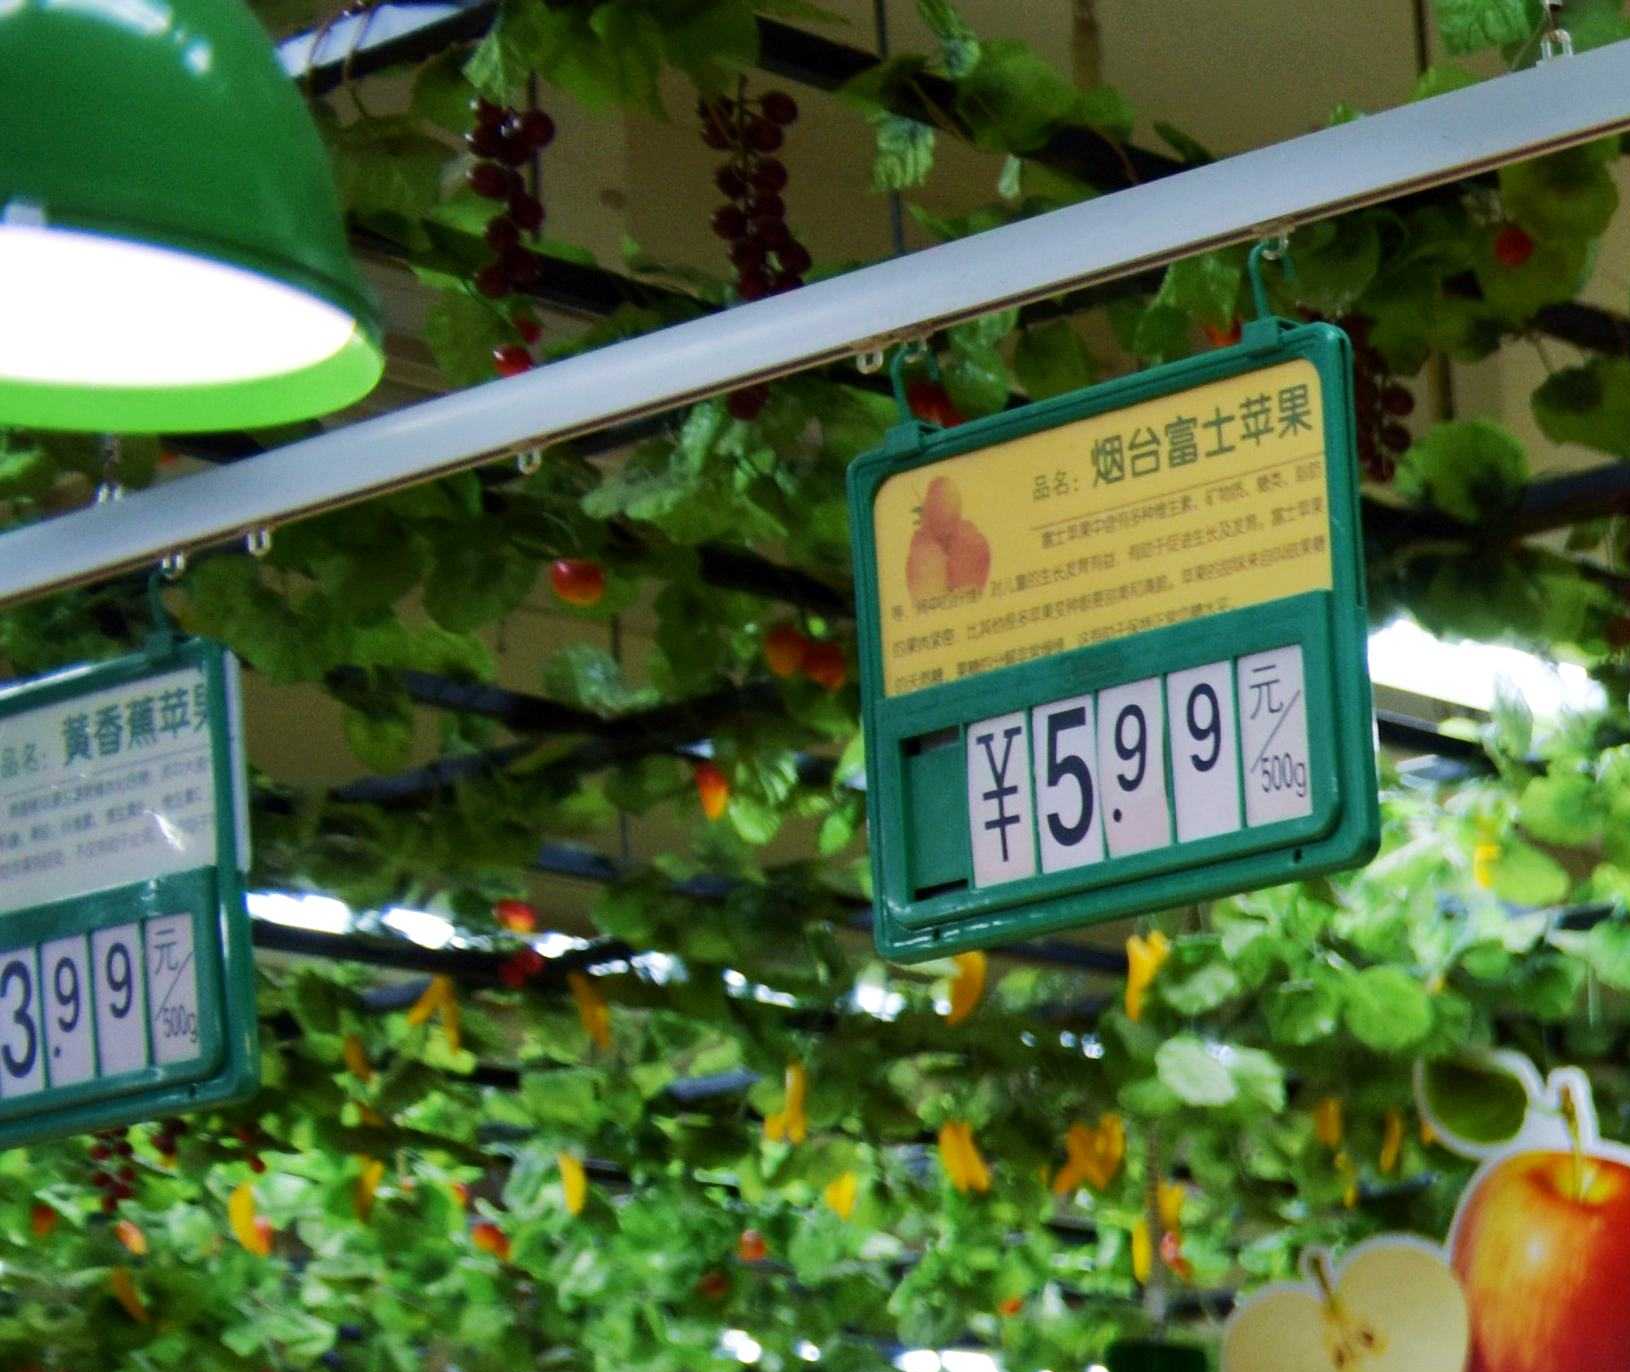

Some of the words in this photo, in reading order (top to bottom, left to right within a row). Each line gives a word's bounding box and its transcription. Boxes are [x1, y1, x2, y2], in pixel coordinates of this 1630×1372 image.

[1090, 383, 1313, 487] 烟台富士苹果
[975, 681, 1222, 864] ¥5.99
